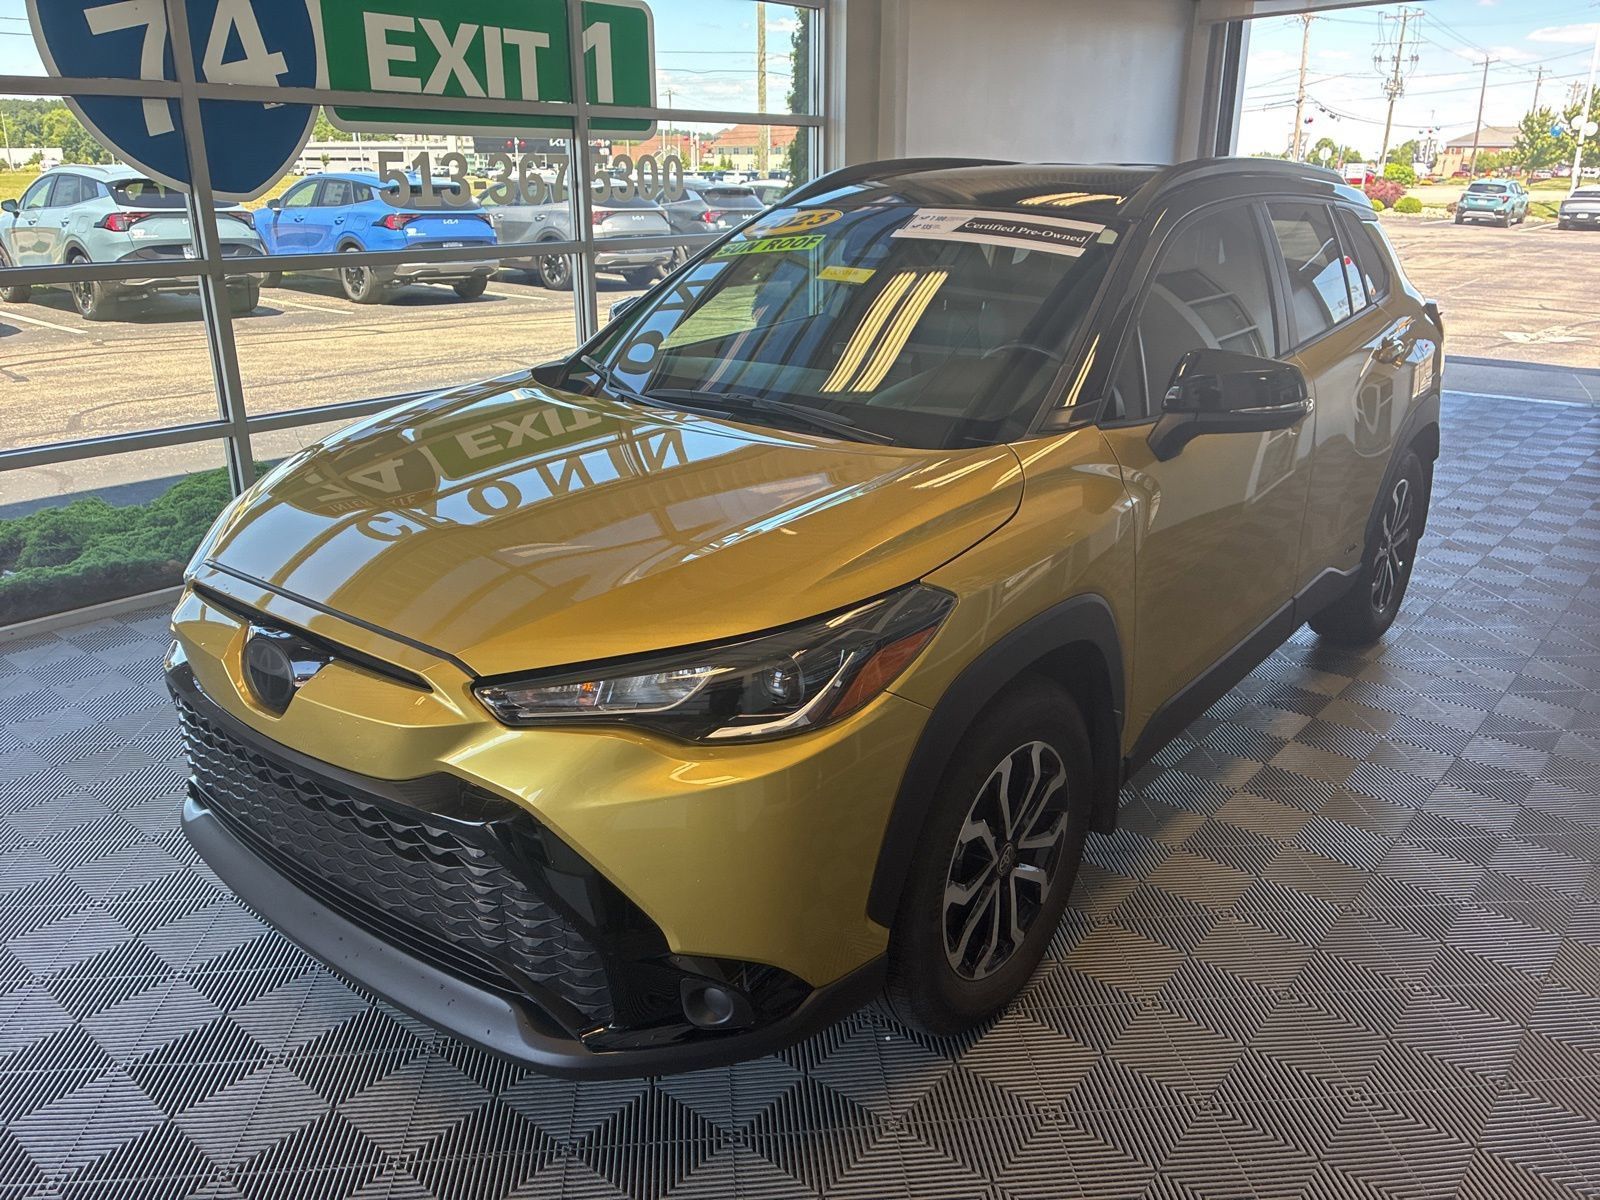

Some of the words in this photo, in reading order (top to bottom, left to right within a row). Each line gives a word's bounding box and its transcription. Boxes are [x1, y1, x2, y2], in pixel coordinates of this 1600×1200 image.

[85, 0, 288, 137] 74
[363, 11, 550, 102] EXIT
[583, 22, 613, 104] 1
[377, 150, 684, 207] 513-3675300
[717, 239, 760, 256] SUN
[761, 236, 820, 251] ROOF
[964, 221, 1018, 234] Certified
[1018, 226, 1087, 244] Pre-Owned
